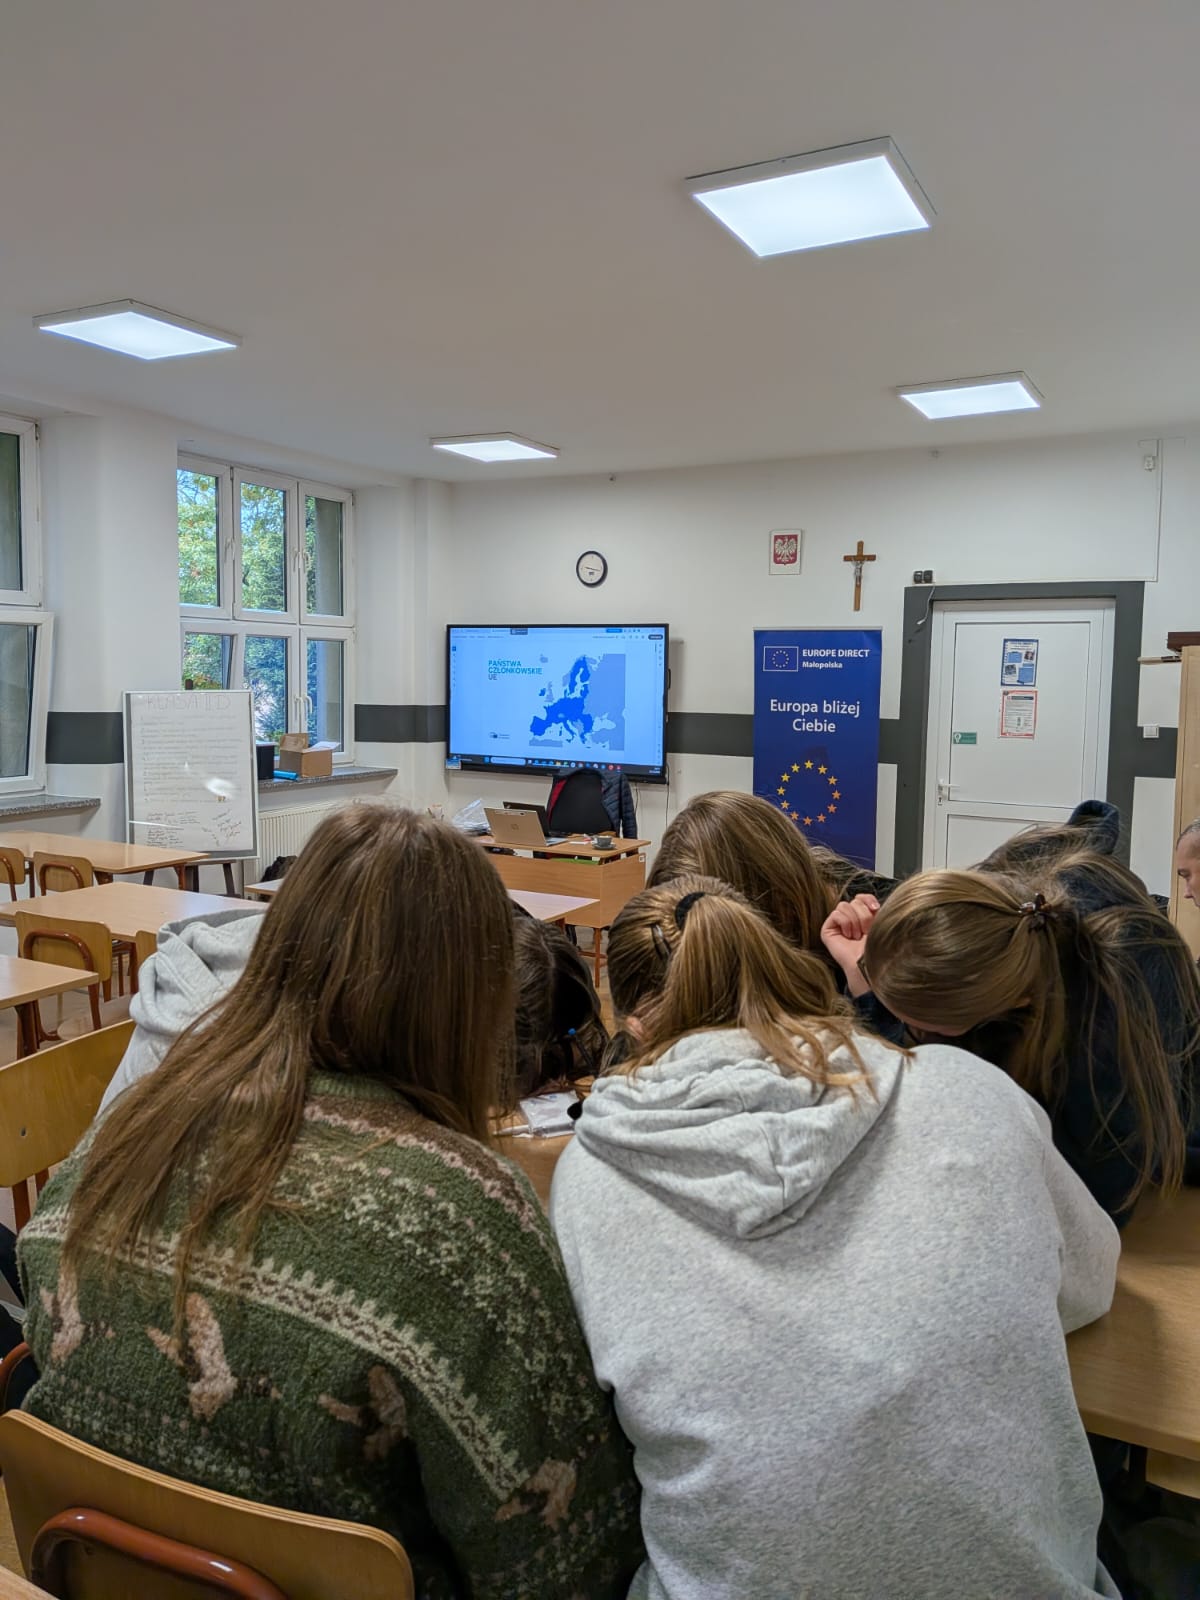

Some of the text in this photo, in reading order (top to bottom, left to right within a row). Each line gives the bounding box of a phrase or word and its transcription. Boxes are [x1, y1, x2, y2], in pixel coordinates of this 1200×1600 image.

[802, 649, 870, 658] EUROPE DIRECT
[488, 658, 522, 667] PAŃSTWA
[802, 661, 843, 669] Małopolska
[488, 667, 542, 675] CZŁONKOWSKIE
[770, 699, 861, 718] Europa bliżej
[792, 718, 836, 733] Ciebie
